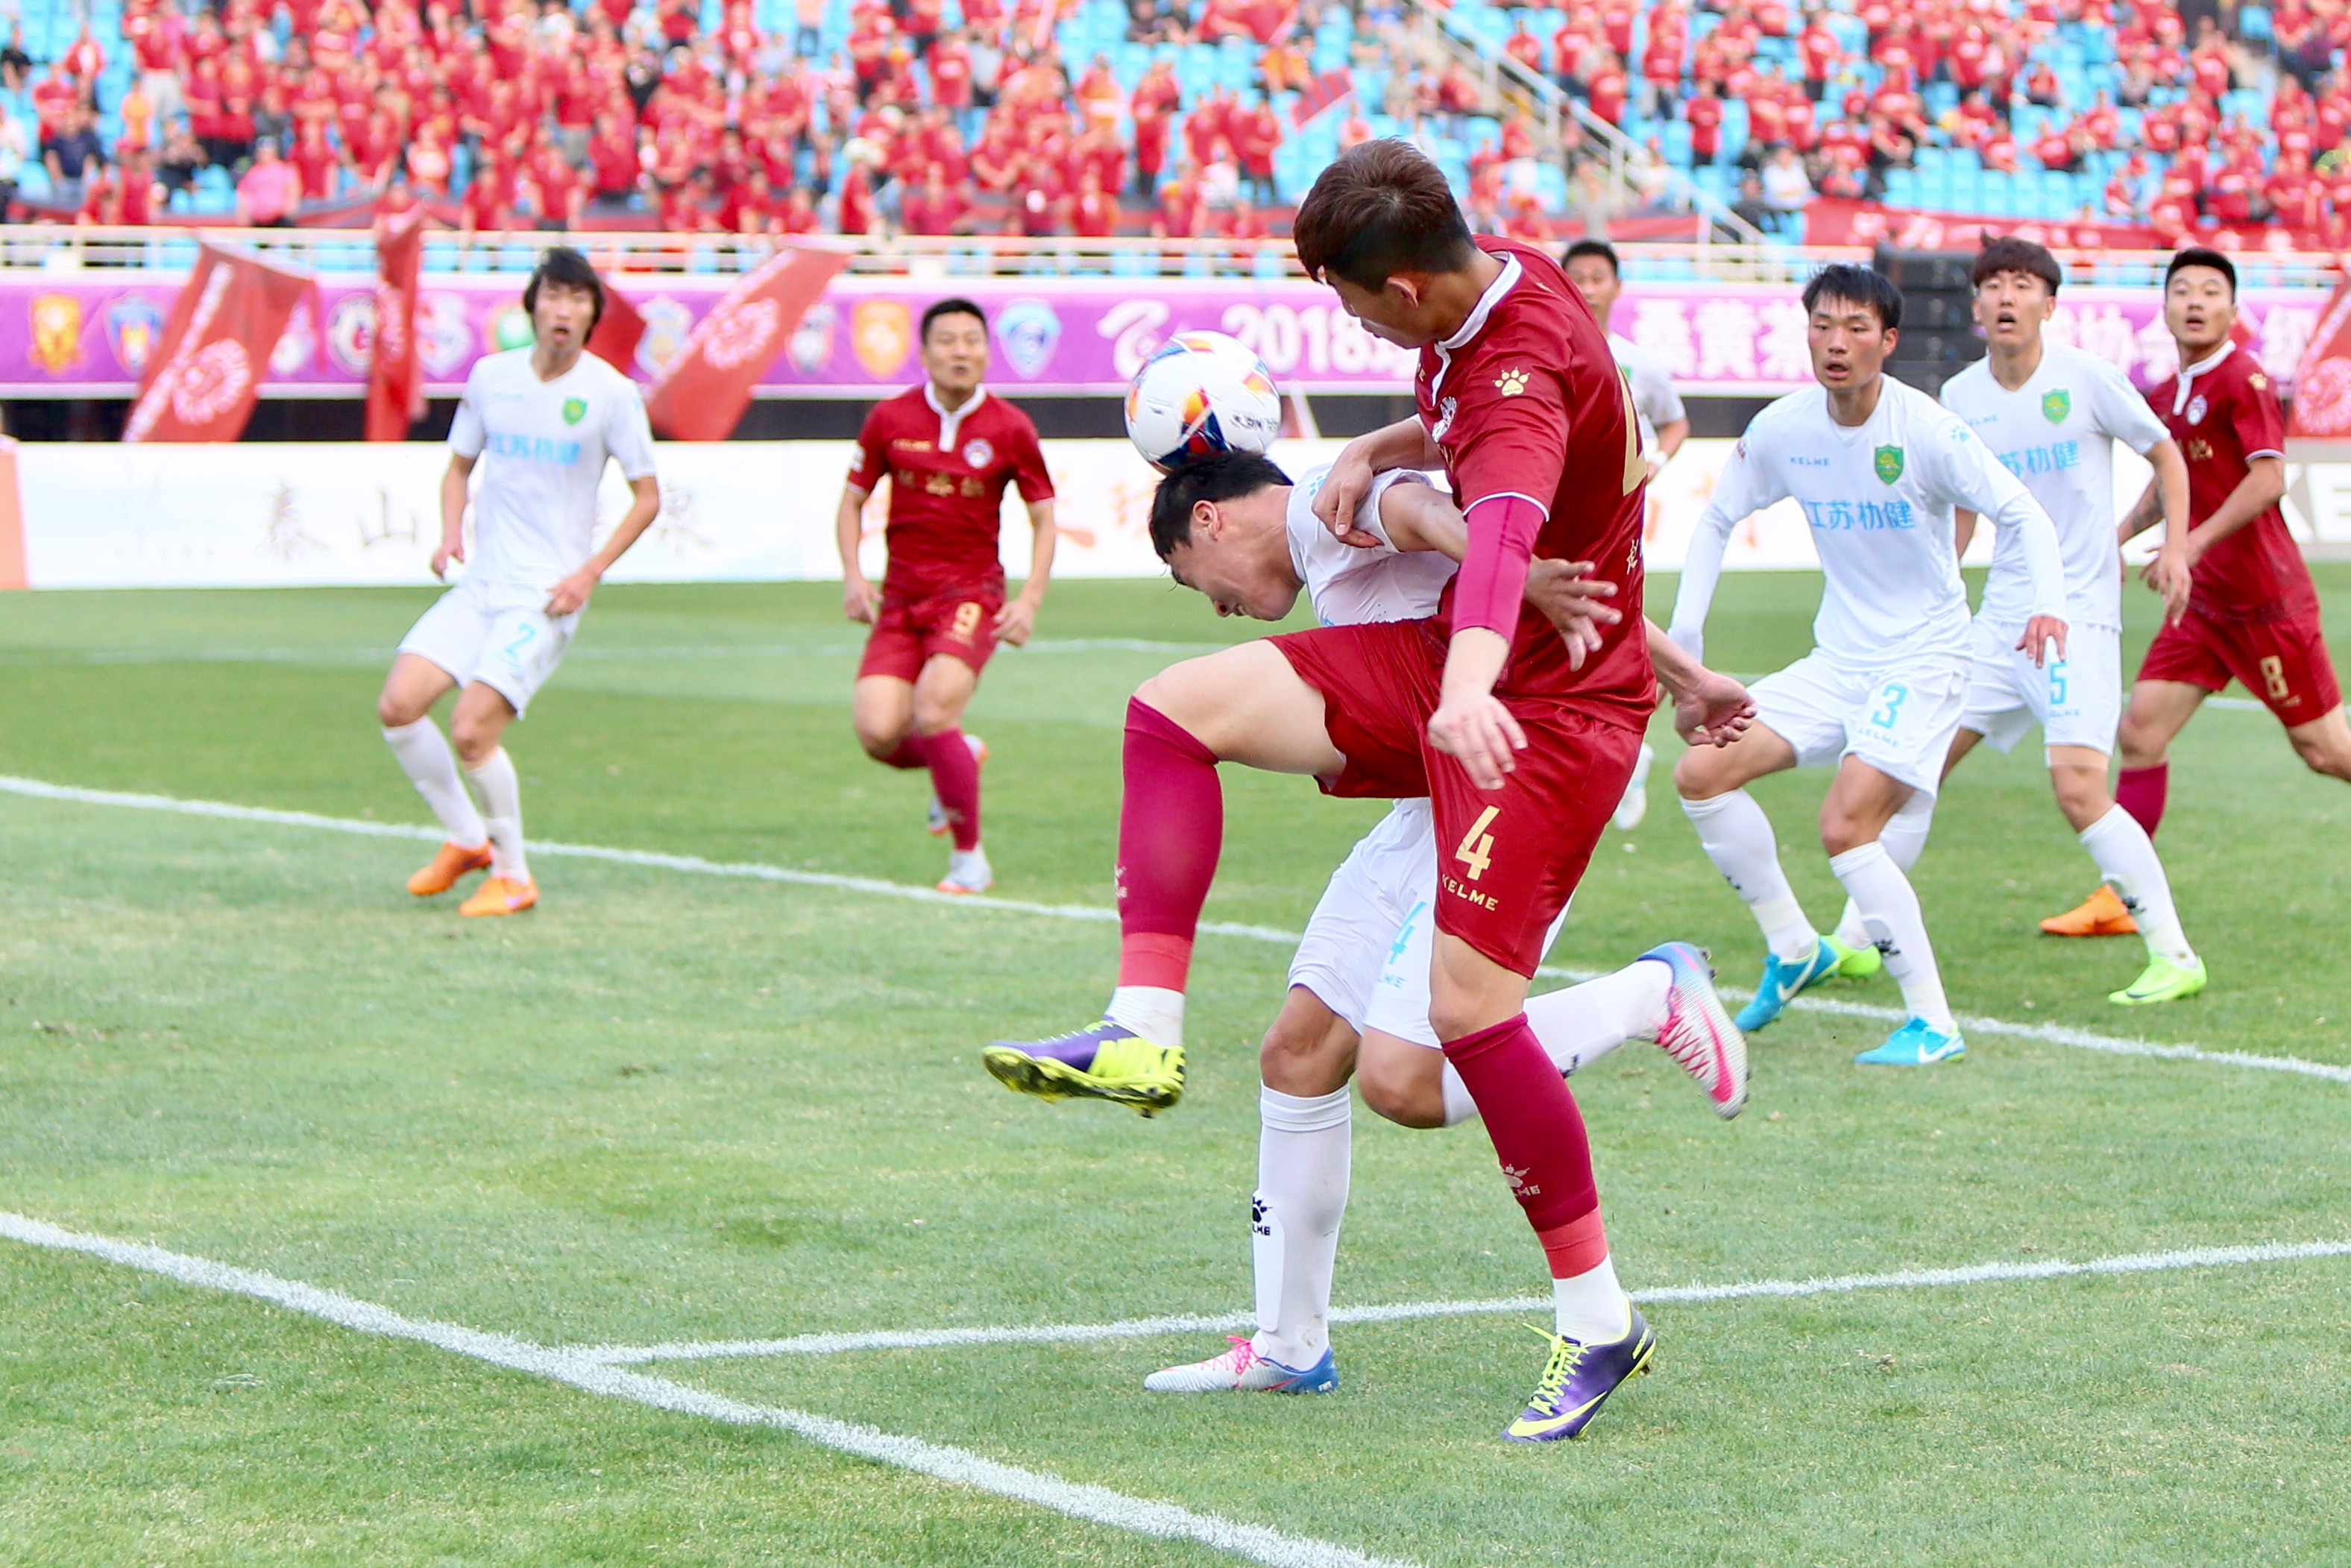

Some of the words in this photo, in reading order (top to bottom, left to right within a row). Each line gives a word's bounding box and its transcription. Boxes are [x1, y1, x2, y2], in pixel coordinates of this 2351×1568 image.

[1790, 456, 1831, 466] KELME
[505, 623, 536, 658] 2
[952, 602, 983, 636] 9
[2049, 661, 2067, 705] 5
[2259, 655, 2290, 700] 8
[1871, 684, 1908, 729] 3
[1455, 805, 1501, 881] 4
[1442, 873, 1499, 912] KELME
[1388, 901, 1428, 965] 4
